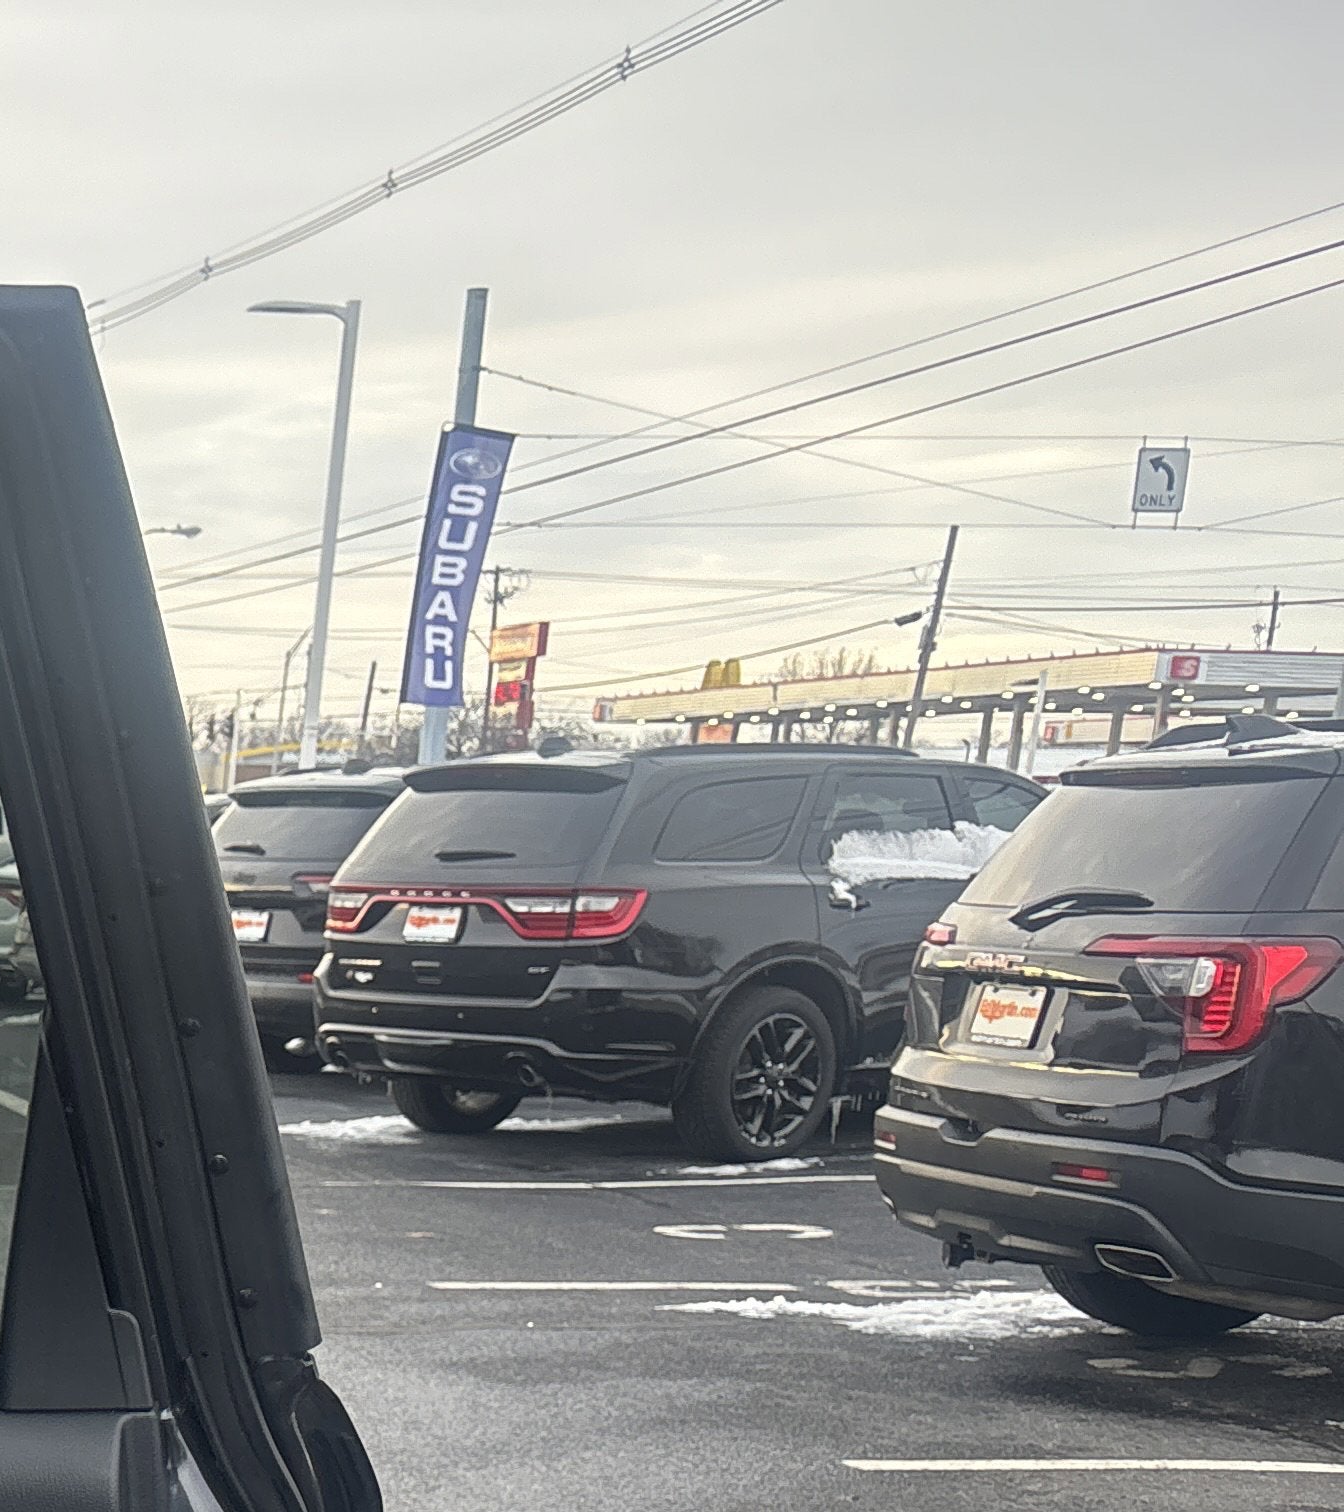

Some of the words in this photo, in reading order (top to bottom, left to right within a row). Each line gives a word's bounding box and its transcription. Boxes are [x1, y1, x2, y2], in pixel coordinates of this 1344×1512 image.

[1139, 493, 1177, 507] ONLY
[424, 483, 487, 690] SUBARU
[965, 951, 1027, 975] GMC
